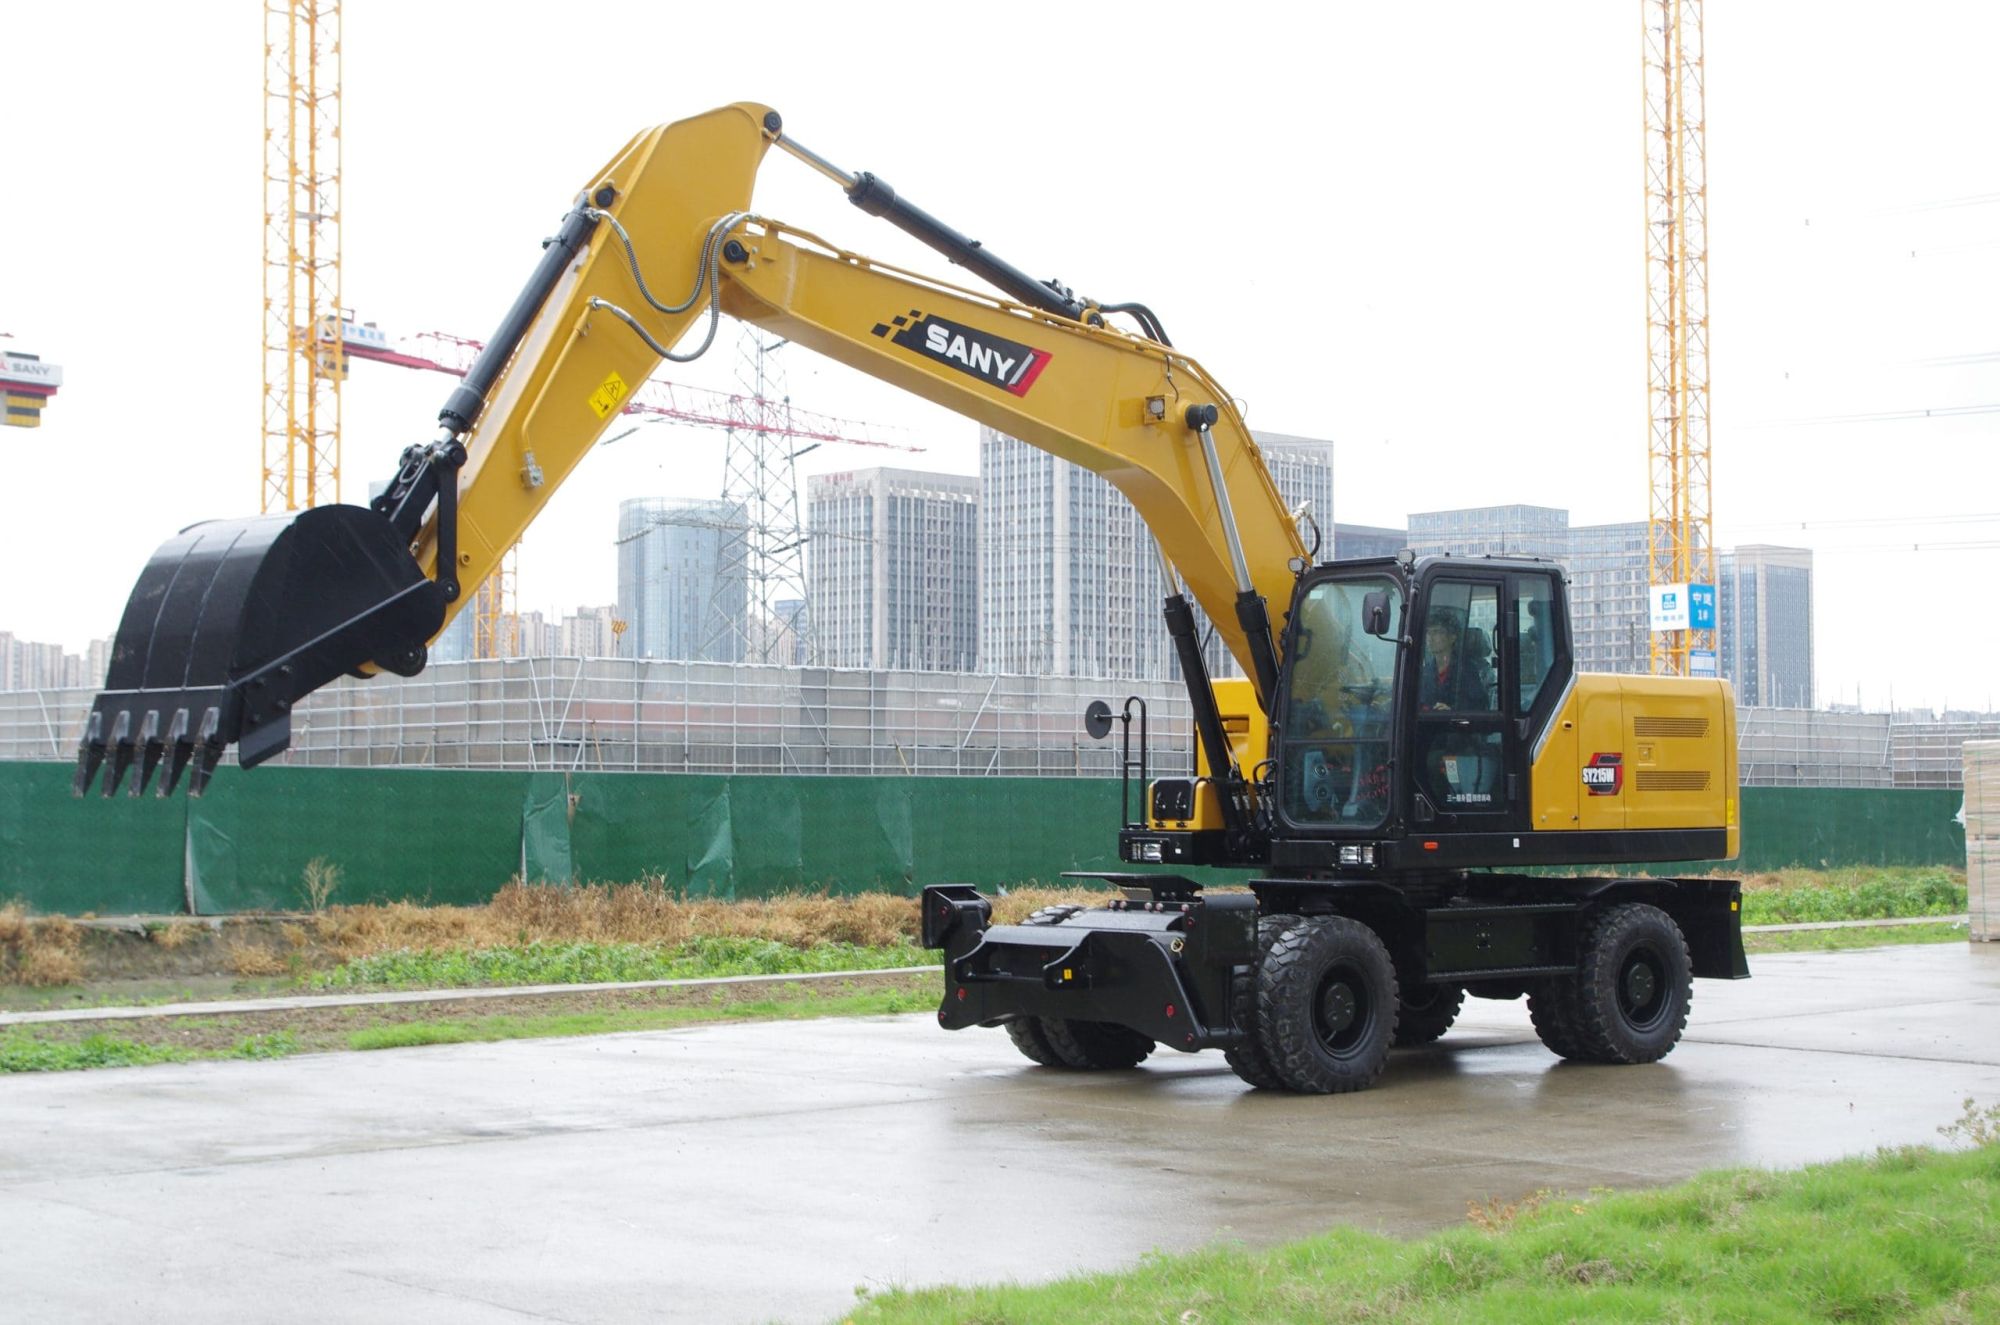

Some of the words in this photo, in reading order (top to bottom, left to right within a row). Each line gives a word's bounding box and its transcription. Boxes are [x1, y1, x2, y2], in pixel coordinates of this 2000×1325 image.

[925, 323, 1016, 381] SANY
[12, 363, 50, 376] SANY
[1583, 767, 1615, 783] SY215W
